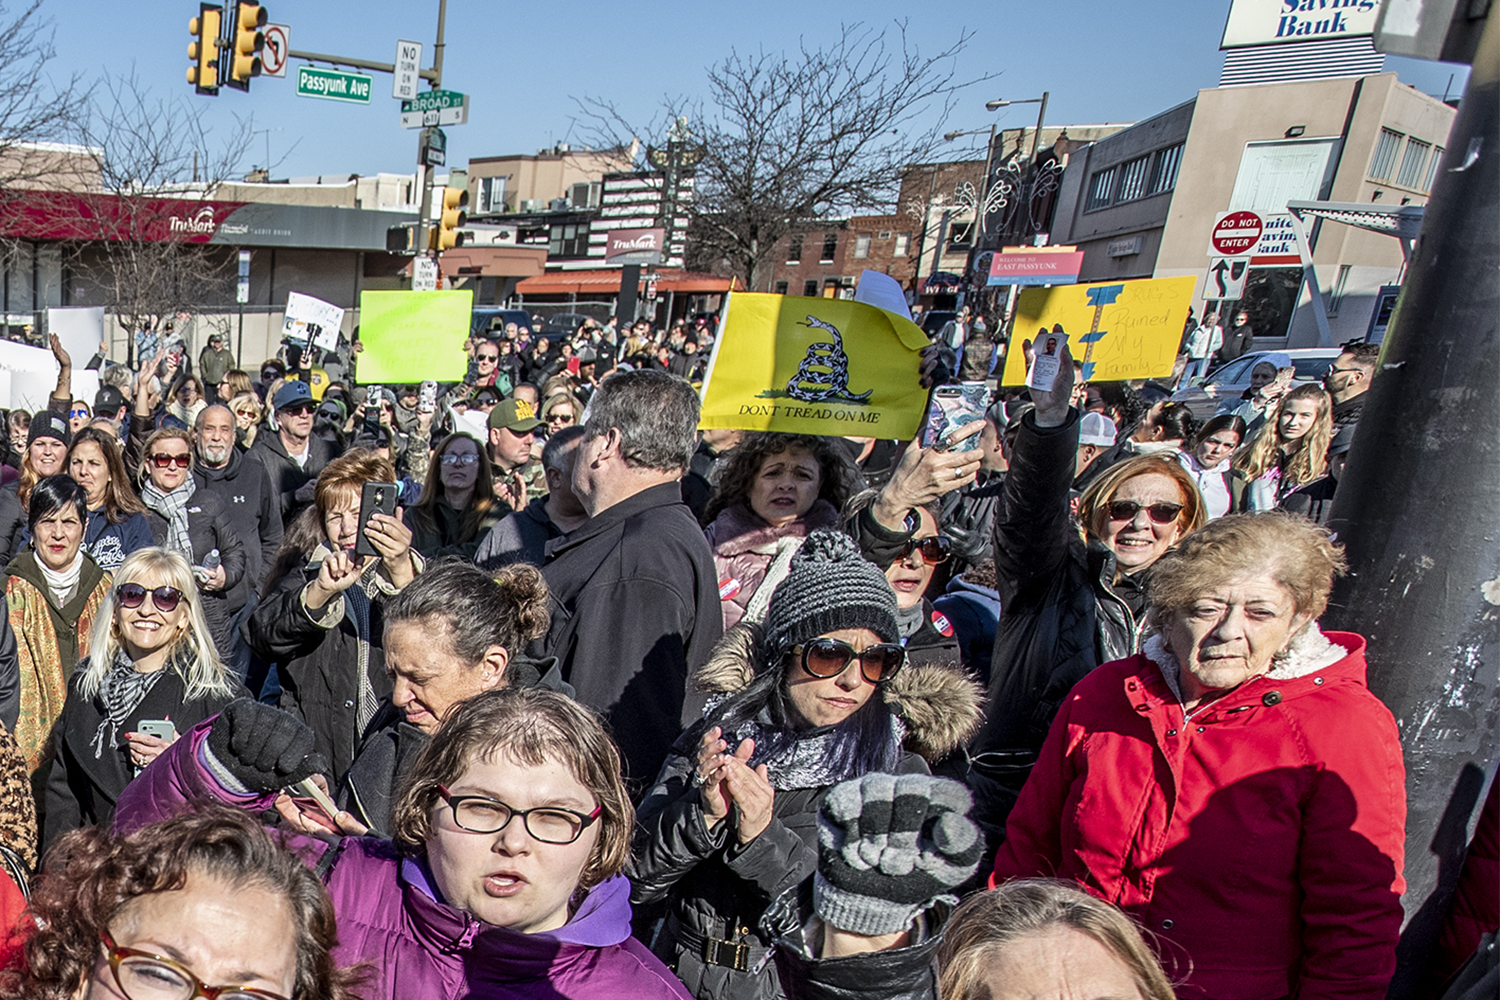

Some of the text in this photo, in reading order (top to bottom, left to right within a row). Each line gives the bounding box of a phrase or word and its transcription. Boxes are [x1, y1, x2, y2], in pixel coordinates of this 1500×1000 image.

[1274, 11, 1349, 38] Bank
[402, 46, 417, 60] NO
[400, 61, 416, 72] TURN
[300, 72, 369, 97] Passyunk Ave
[402, 74, 411, 84] ON
[400, 85, 411, 96] RED
[411, 96, 462, 111] BROAD ST
[425, 113, 438, 124] 611
[455, 111, 460, 119] S
[169, 212, 216, 234] TruMark
[1221, 218, 1258, 228] DO NOT
[613, 236, 656, 249] TruMark
[1220, 238, 1249, 248] ENTER
[420, 261, 432, 269] NO
[1017, 262, 1057, 270] PASSYUNK
[424, 280, 434, 288] RED
[1115, 283, 1180, 306] DRUGS
[1107, 308, 1171, 333] Ruined
[784, 406, 832, 420] TREAD
[834, 410, 855, 422] ON
[858, 412, 881, 424] ME
